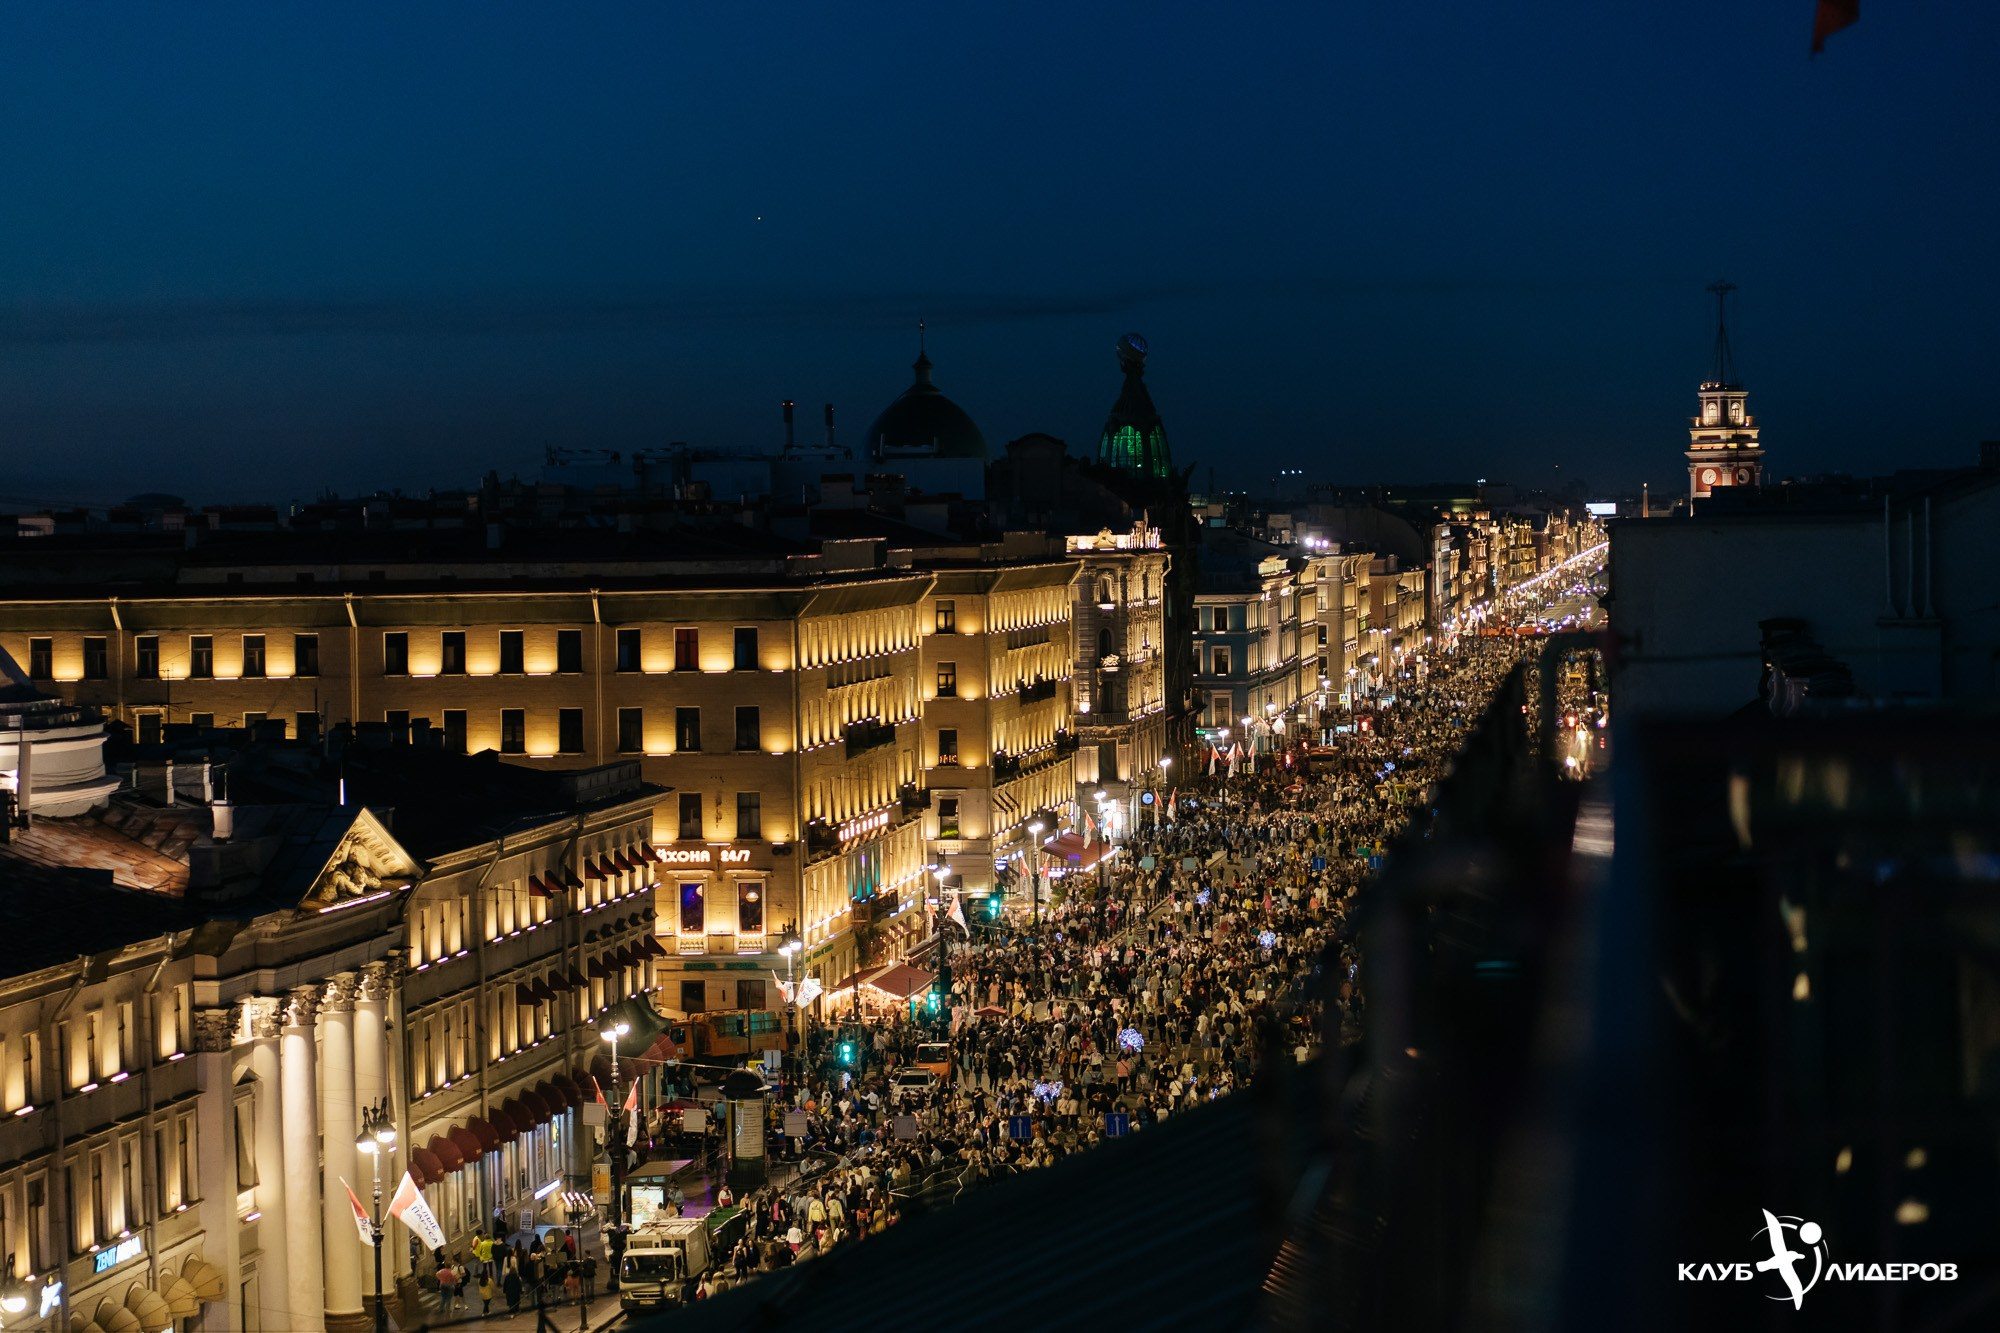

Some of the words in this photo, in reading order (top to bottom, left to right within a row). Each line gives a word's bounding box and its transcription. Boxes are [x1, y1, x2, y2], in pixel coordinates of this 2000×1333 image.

[720, 849, 751, 862] 24/7
[411, 1206, 439, 1244] ПАРУСА
[96, 1246, 117, 1273] ZENIT
